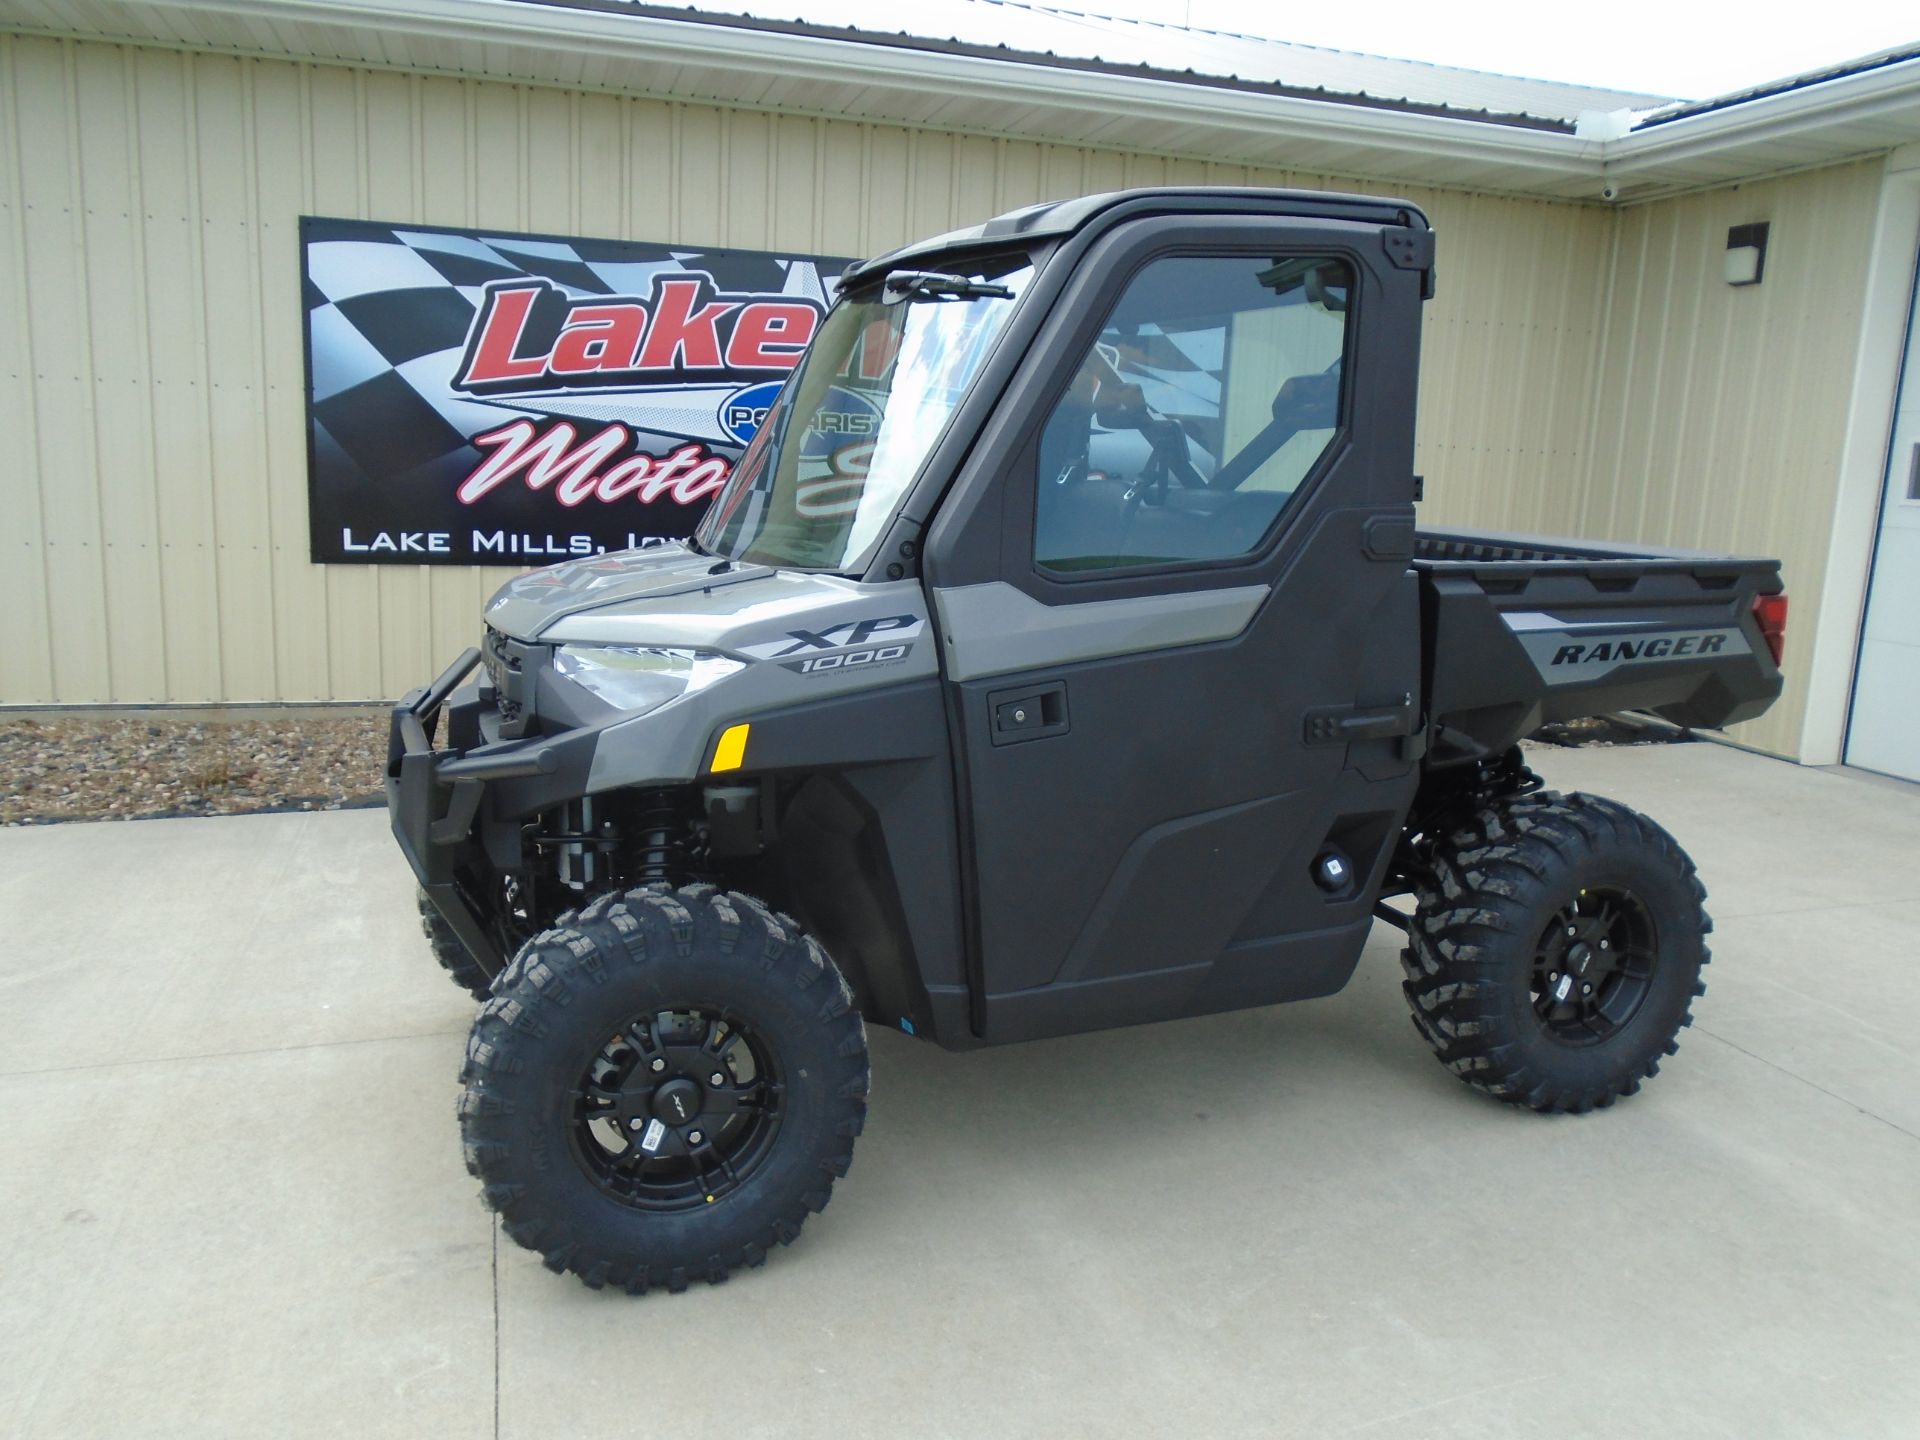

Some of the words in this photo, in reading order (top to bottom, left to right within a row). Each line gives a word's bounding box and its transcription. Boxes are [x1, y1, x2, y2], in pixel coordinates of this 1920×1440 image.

[465, 279, 819, 385] Lake
[343, 528, 450, 551] LAKE
[769, 613, 919, 658] XP
[1551, 633, 1728, 666] RANGER
[801, 645, 906, 673] 1000
